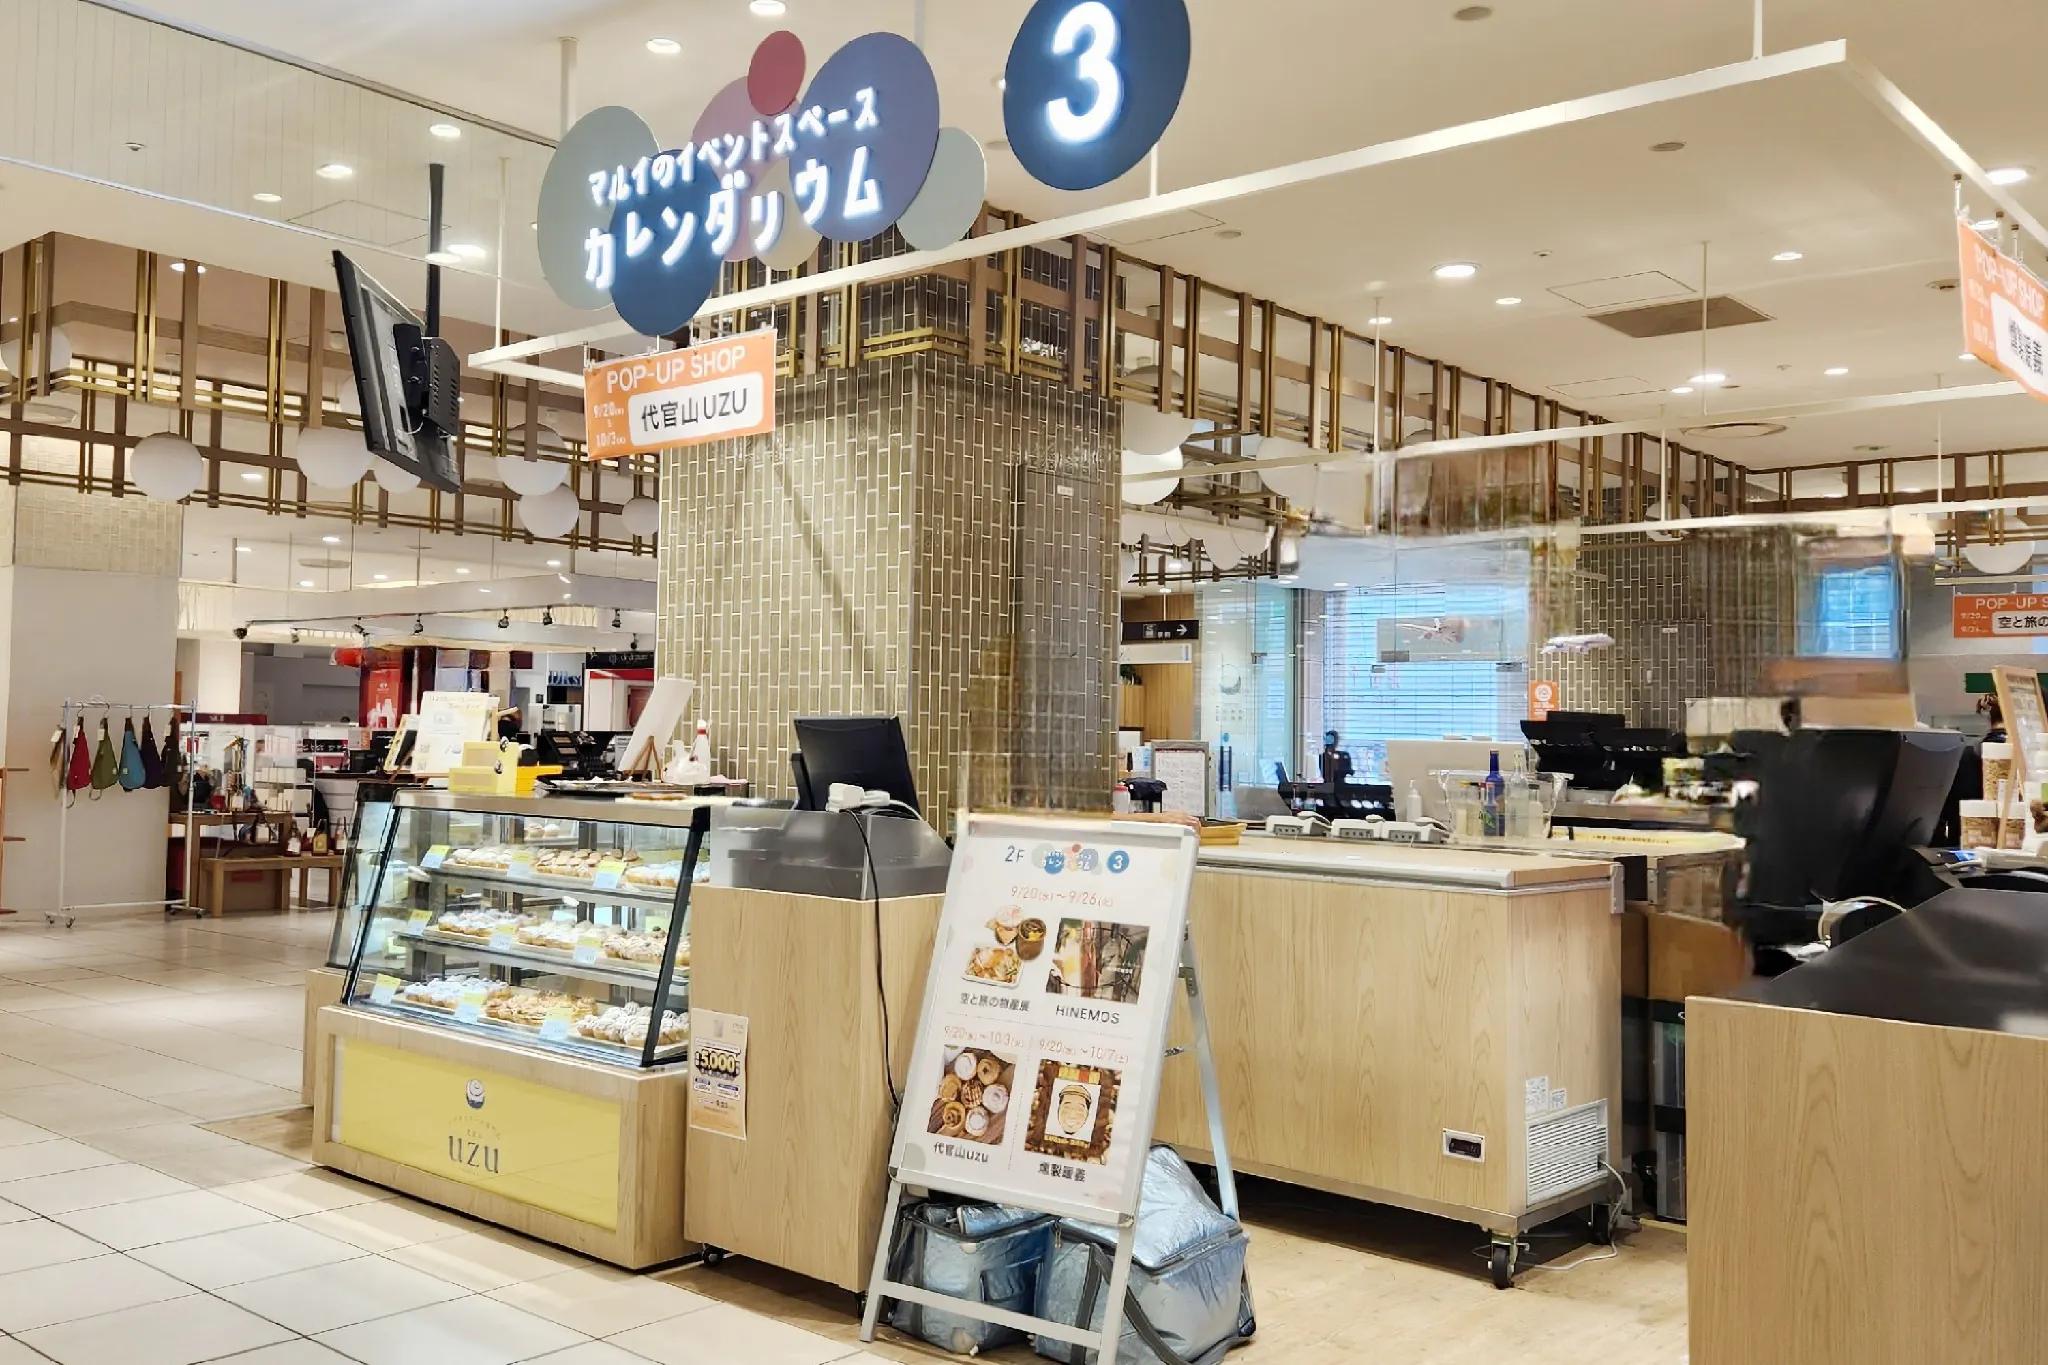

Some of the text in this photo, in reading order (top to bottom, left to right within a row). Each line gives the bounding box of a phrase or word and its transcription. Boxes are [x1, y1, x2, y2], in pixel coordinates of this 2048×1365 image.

[1046, 1, 1124, 143] 3
[588, 85, 880, 207] マルイのイベントスペース
[584, 145, 883, 290] カレンダリウム
[606, 345, 746, 394] POP-UP SHOP
[641, 388, 748, 432] 代官山UZU
[1975, 597, 2038, 610] POP-UP
[1997, 615, 2048, 629] 空と旅の
[1004, 844, 1025, 863] 2F
[1112, 854, 1123, 870] 3
